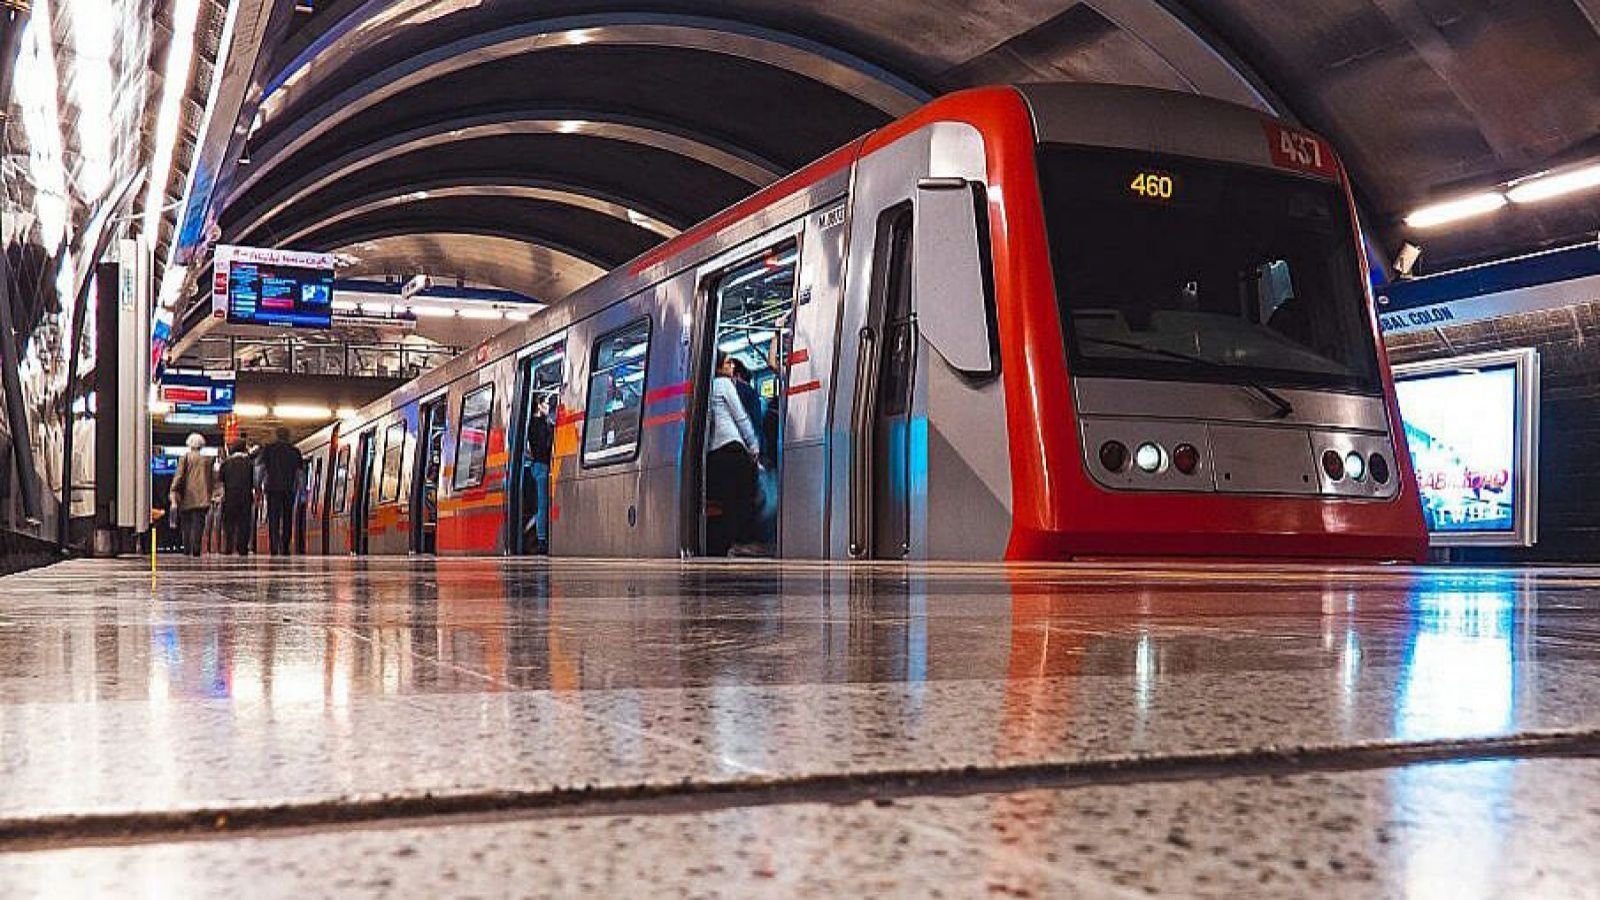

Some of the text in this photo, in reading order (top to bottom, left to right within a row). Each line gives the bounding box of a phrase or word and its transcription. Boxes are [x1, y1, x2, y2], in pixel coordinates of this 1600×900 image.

[1280, 131, 1321, 168] 437
[1130, 173, 1173, 198] 460
[1408, 306, 1454, 325] COLON
